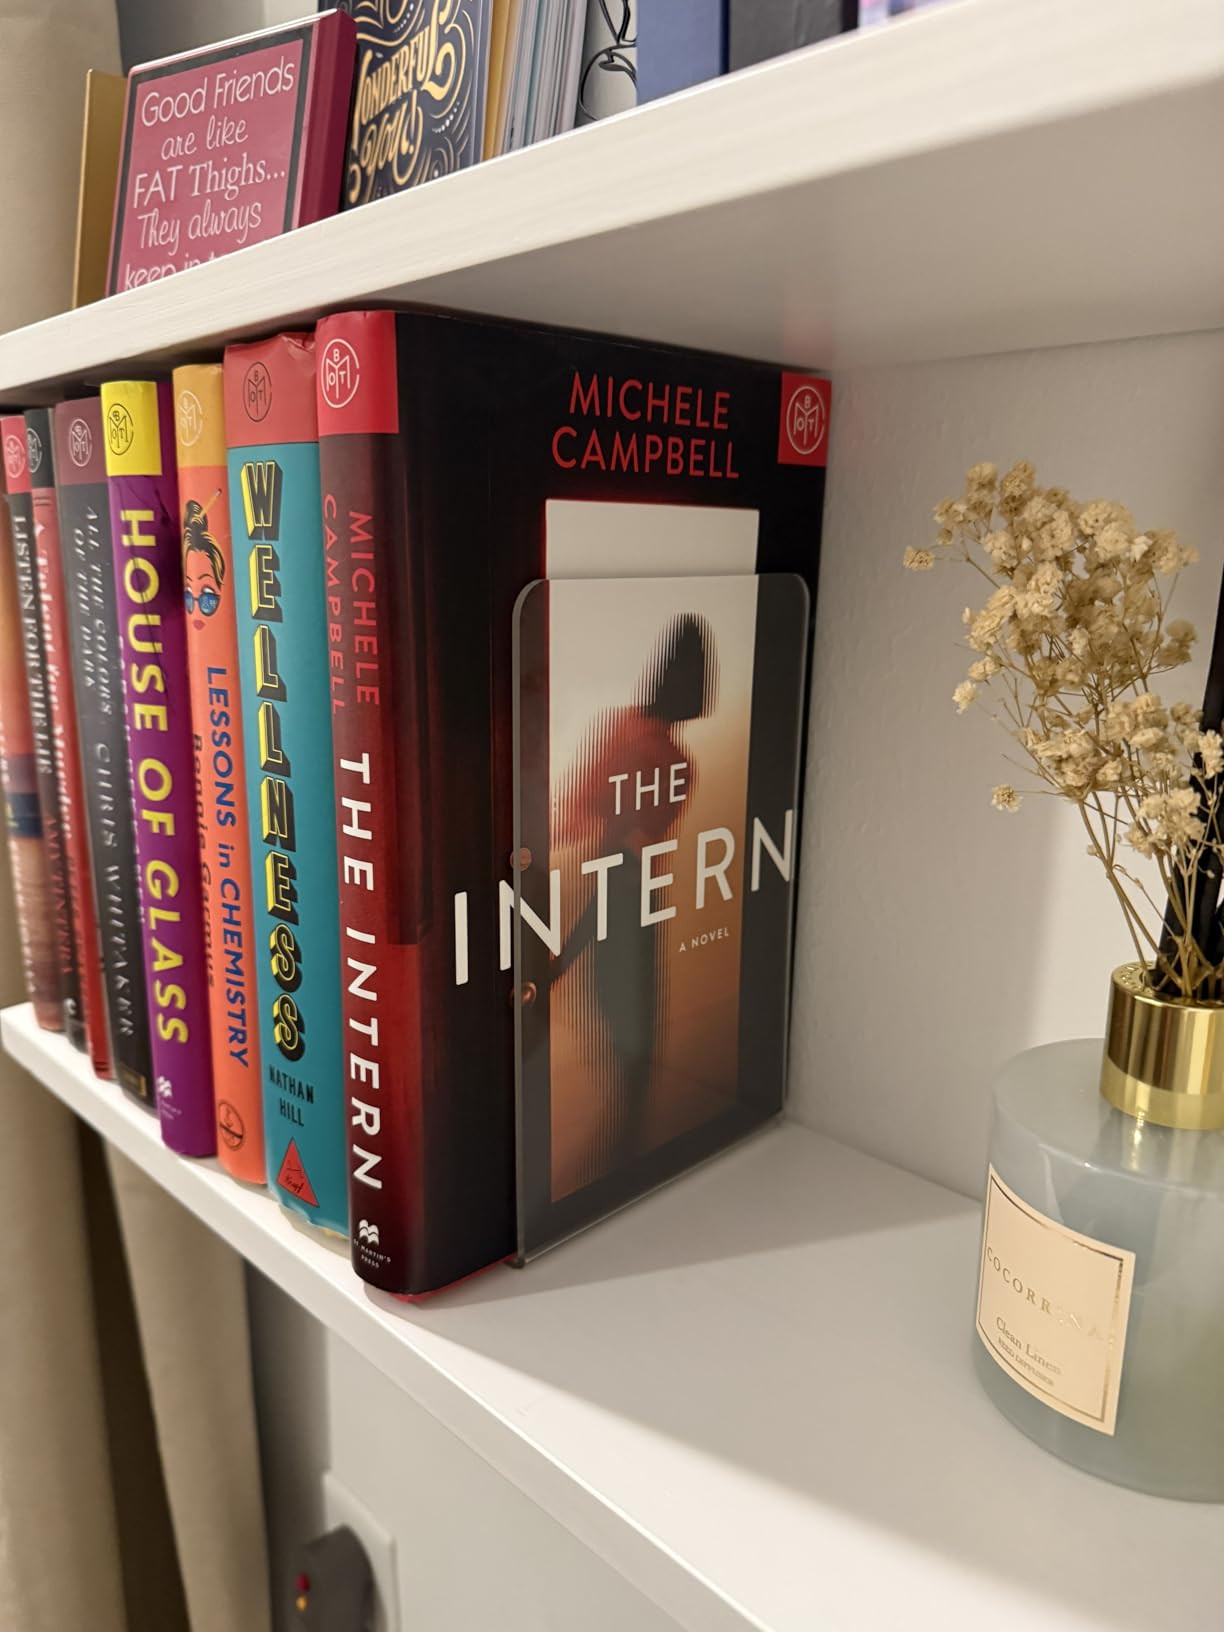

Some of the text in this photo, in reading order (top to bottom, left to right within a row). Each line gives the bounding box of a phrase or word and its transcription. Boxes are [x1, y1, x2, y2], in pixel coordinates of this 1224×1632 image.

[141, 56, 295, 127] Good Friends
[161, 115, 249, 160] are like
[133, 153, 286, 209] FAT Thighs...
[137, 200, 262, 256] They always
[569, 371, 731, 430] MICHELE
[552, 426, 740, 479] CAMPBELL
[14, 514, 36, 611] LISTEN
[120, 508, 168, 732] HOUSE
[323, 494, 346, 715] CAMPBELL
[349, 510, 380, 705] MICHELE
[23, 617, 41, 669] FOR
[95, 617, 112, 716] COLORS
[28, 674, 48, 728] THE
[240, 460, 306, 1063] WELLNESS
[608, 762, 688, 815] THE
[138, 757, 176, 837] OF
[207, 665, 249, 1068] LESSONS in CHEMISTRY
[454, 809, 795, 986] INTERN
[146, 859, 189, 1045] GLASS
[339, 753, 383, 1190] THE INTERN
[678, 927, 730, 953] A NOVEL
[269, 1064, 314, 1104] NATHAN
[279, 1097, 304, 1127] HILL
[996, 1317, 1023, 1350] Clean
